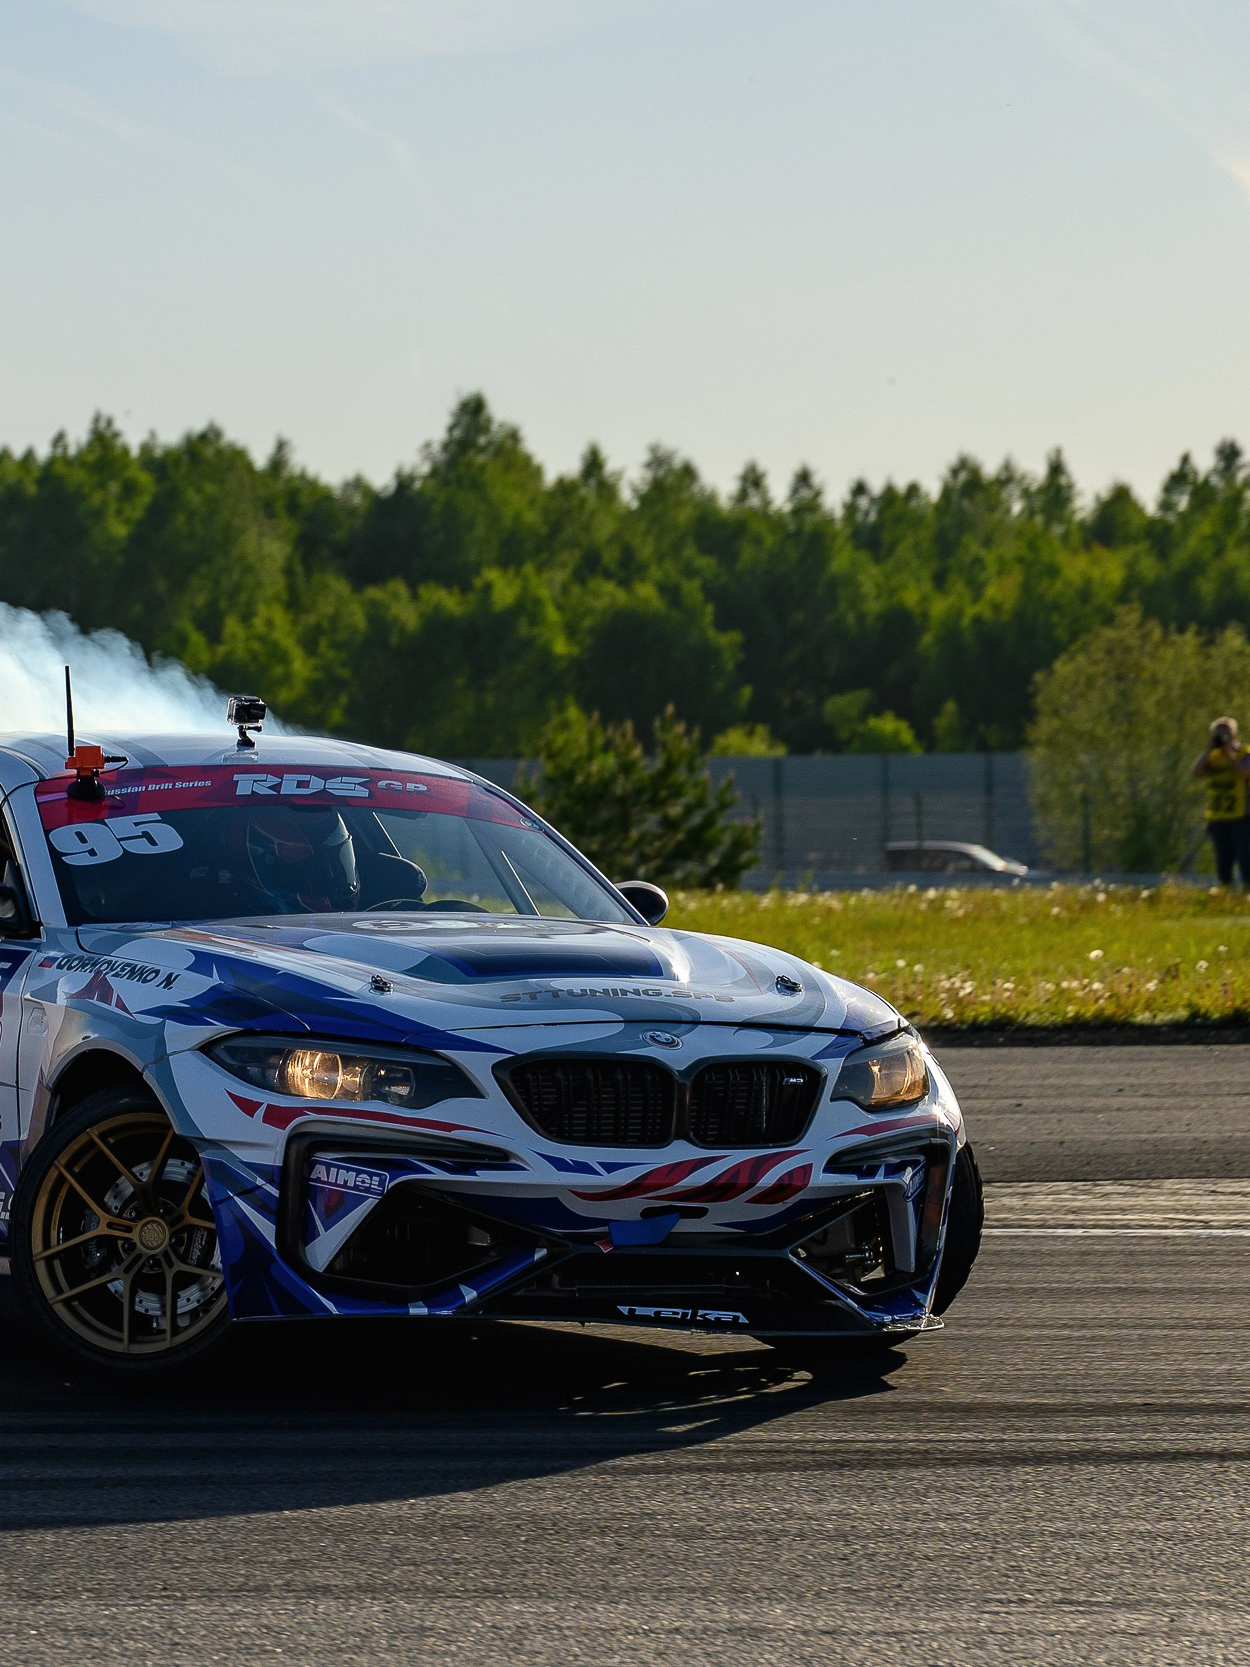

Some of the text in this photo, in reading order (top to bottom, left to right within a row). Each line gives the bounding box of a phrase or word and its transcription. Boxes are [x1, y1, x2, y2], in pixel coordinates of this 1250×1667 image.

[104, 779, 212, 796] ussian Drift Series
[233, 773, 429, 798] RDS GP
[50, 812, 184, 866] 95
[310, 1164, 384, 1193] AIMOL
